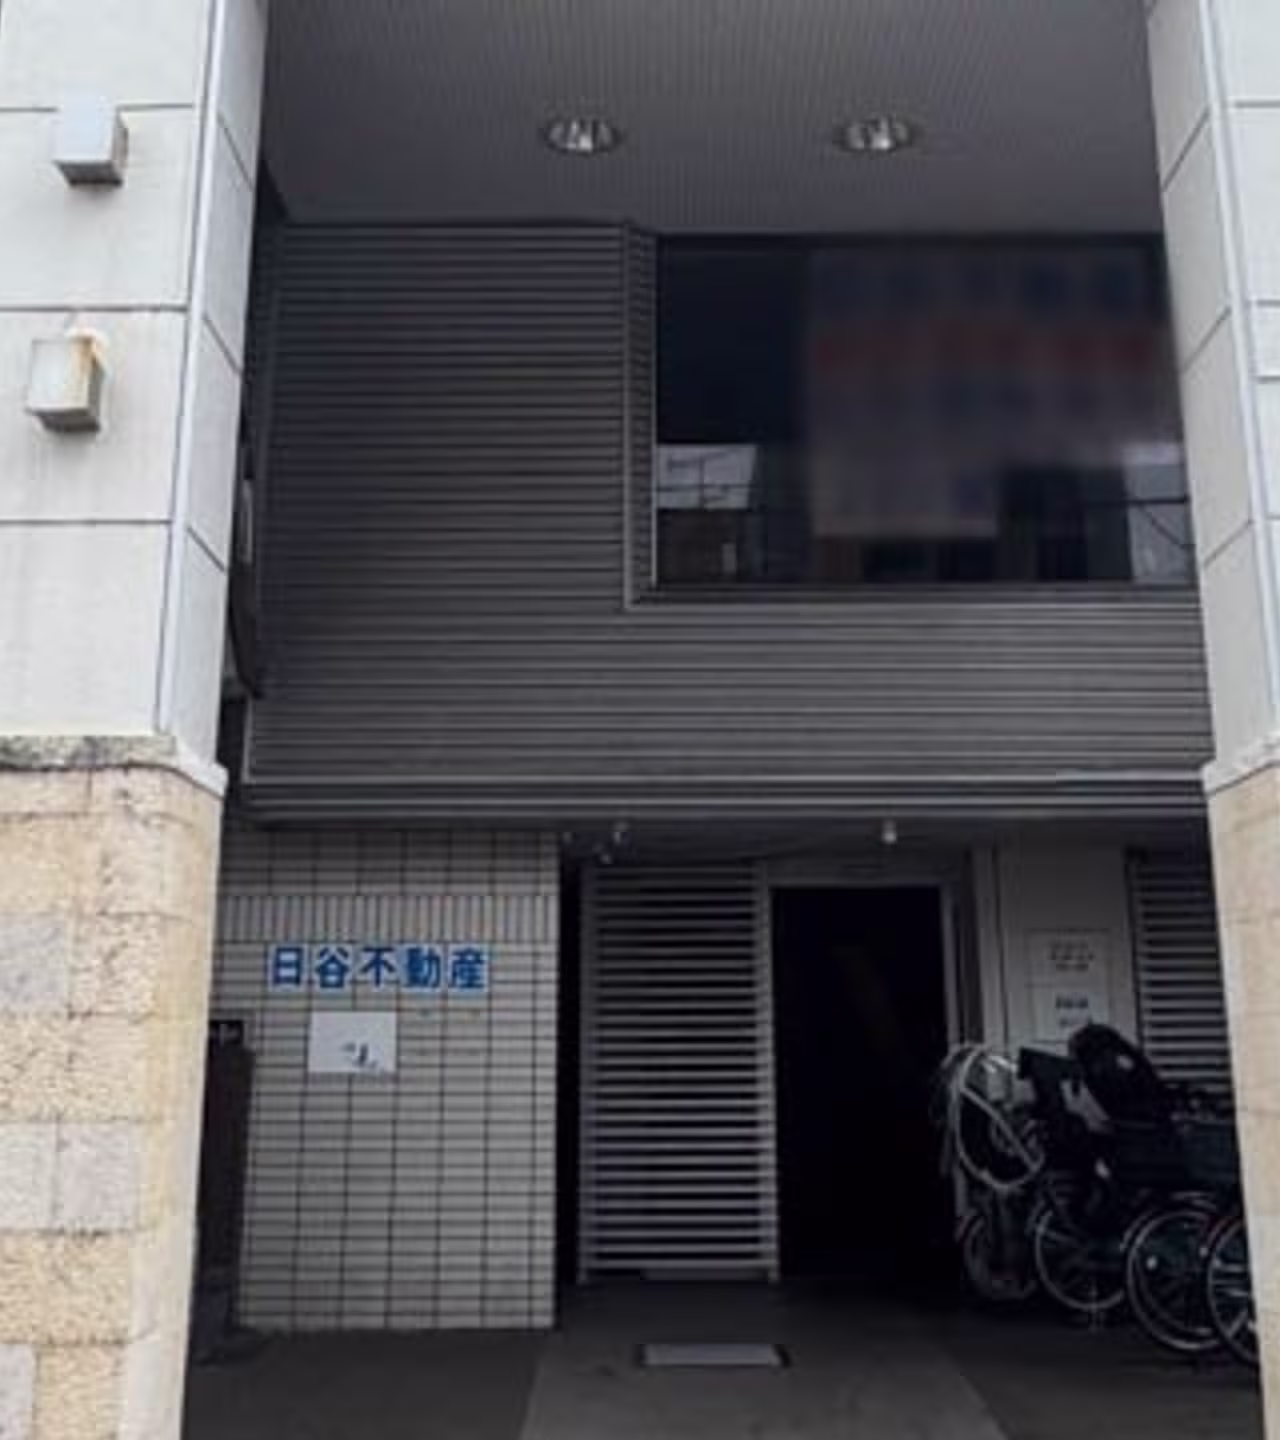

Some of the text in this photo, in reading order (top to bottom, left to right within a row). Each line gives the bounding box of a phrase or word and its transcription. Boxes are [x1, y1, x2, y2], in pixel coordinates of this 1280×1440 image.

[272, 947, 487, 989] 日谷不動産
